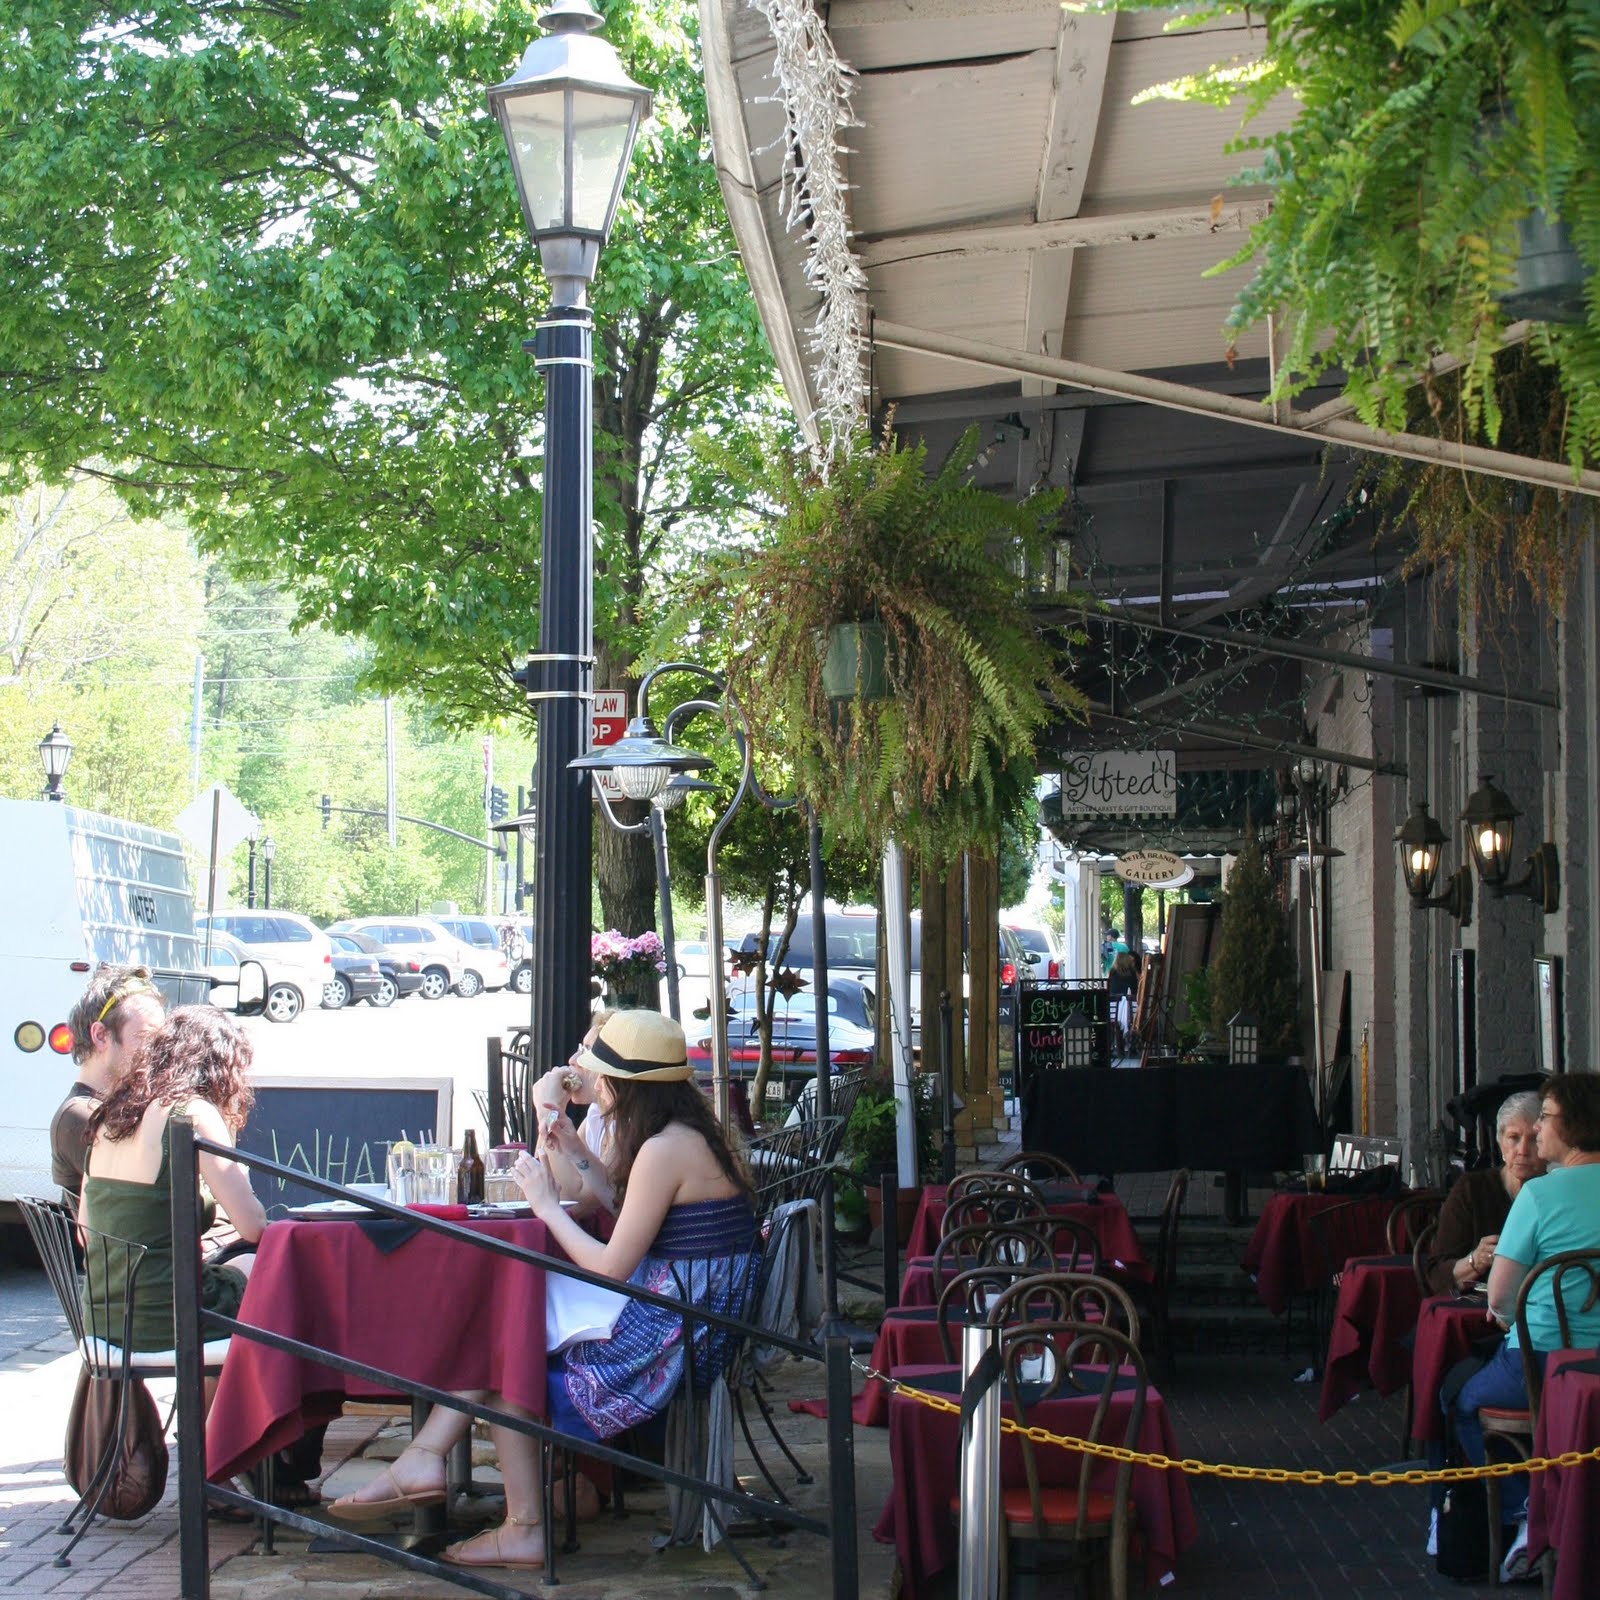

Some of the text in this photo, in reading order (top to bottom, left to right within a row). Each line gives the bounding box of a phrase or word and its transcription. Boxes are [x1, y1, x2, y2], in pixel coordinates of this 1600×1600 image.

[594, 698, 617, 712] LAW
[591, 724, 611, 740] OP
[1125, 869, 1174, 880] GALLERY
[272, 1128, 396, 1192] WHAT
